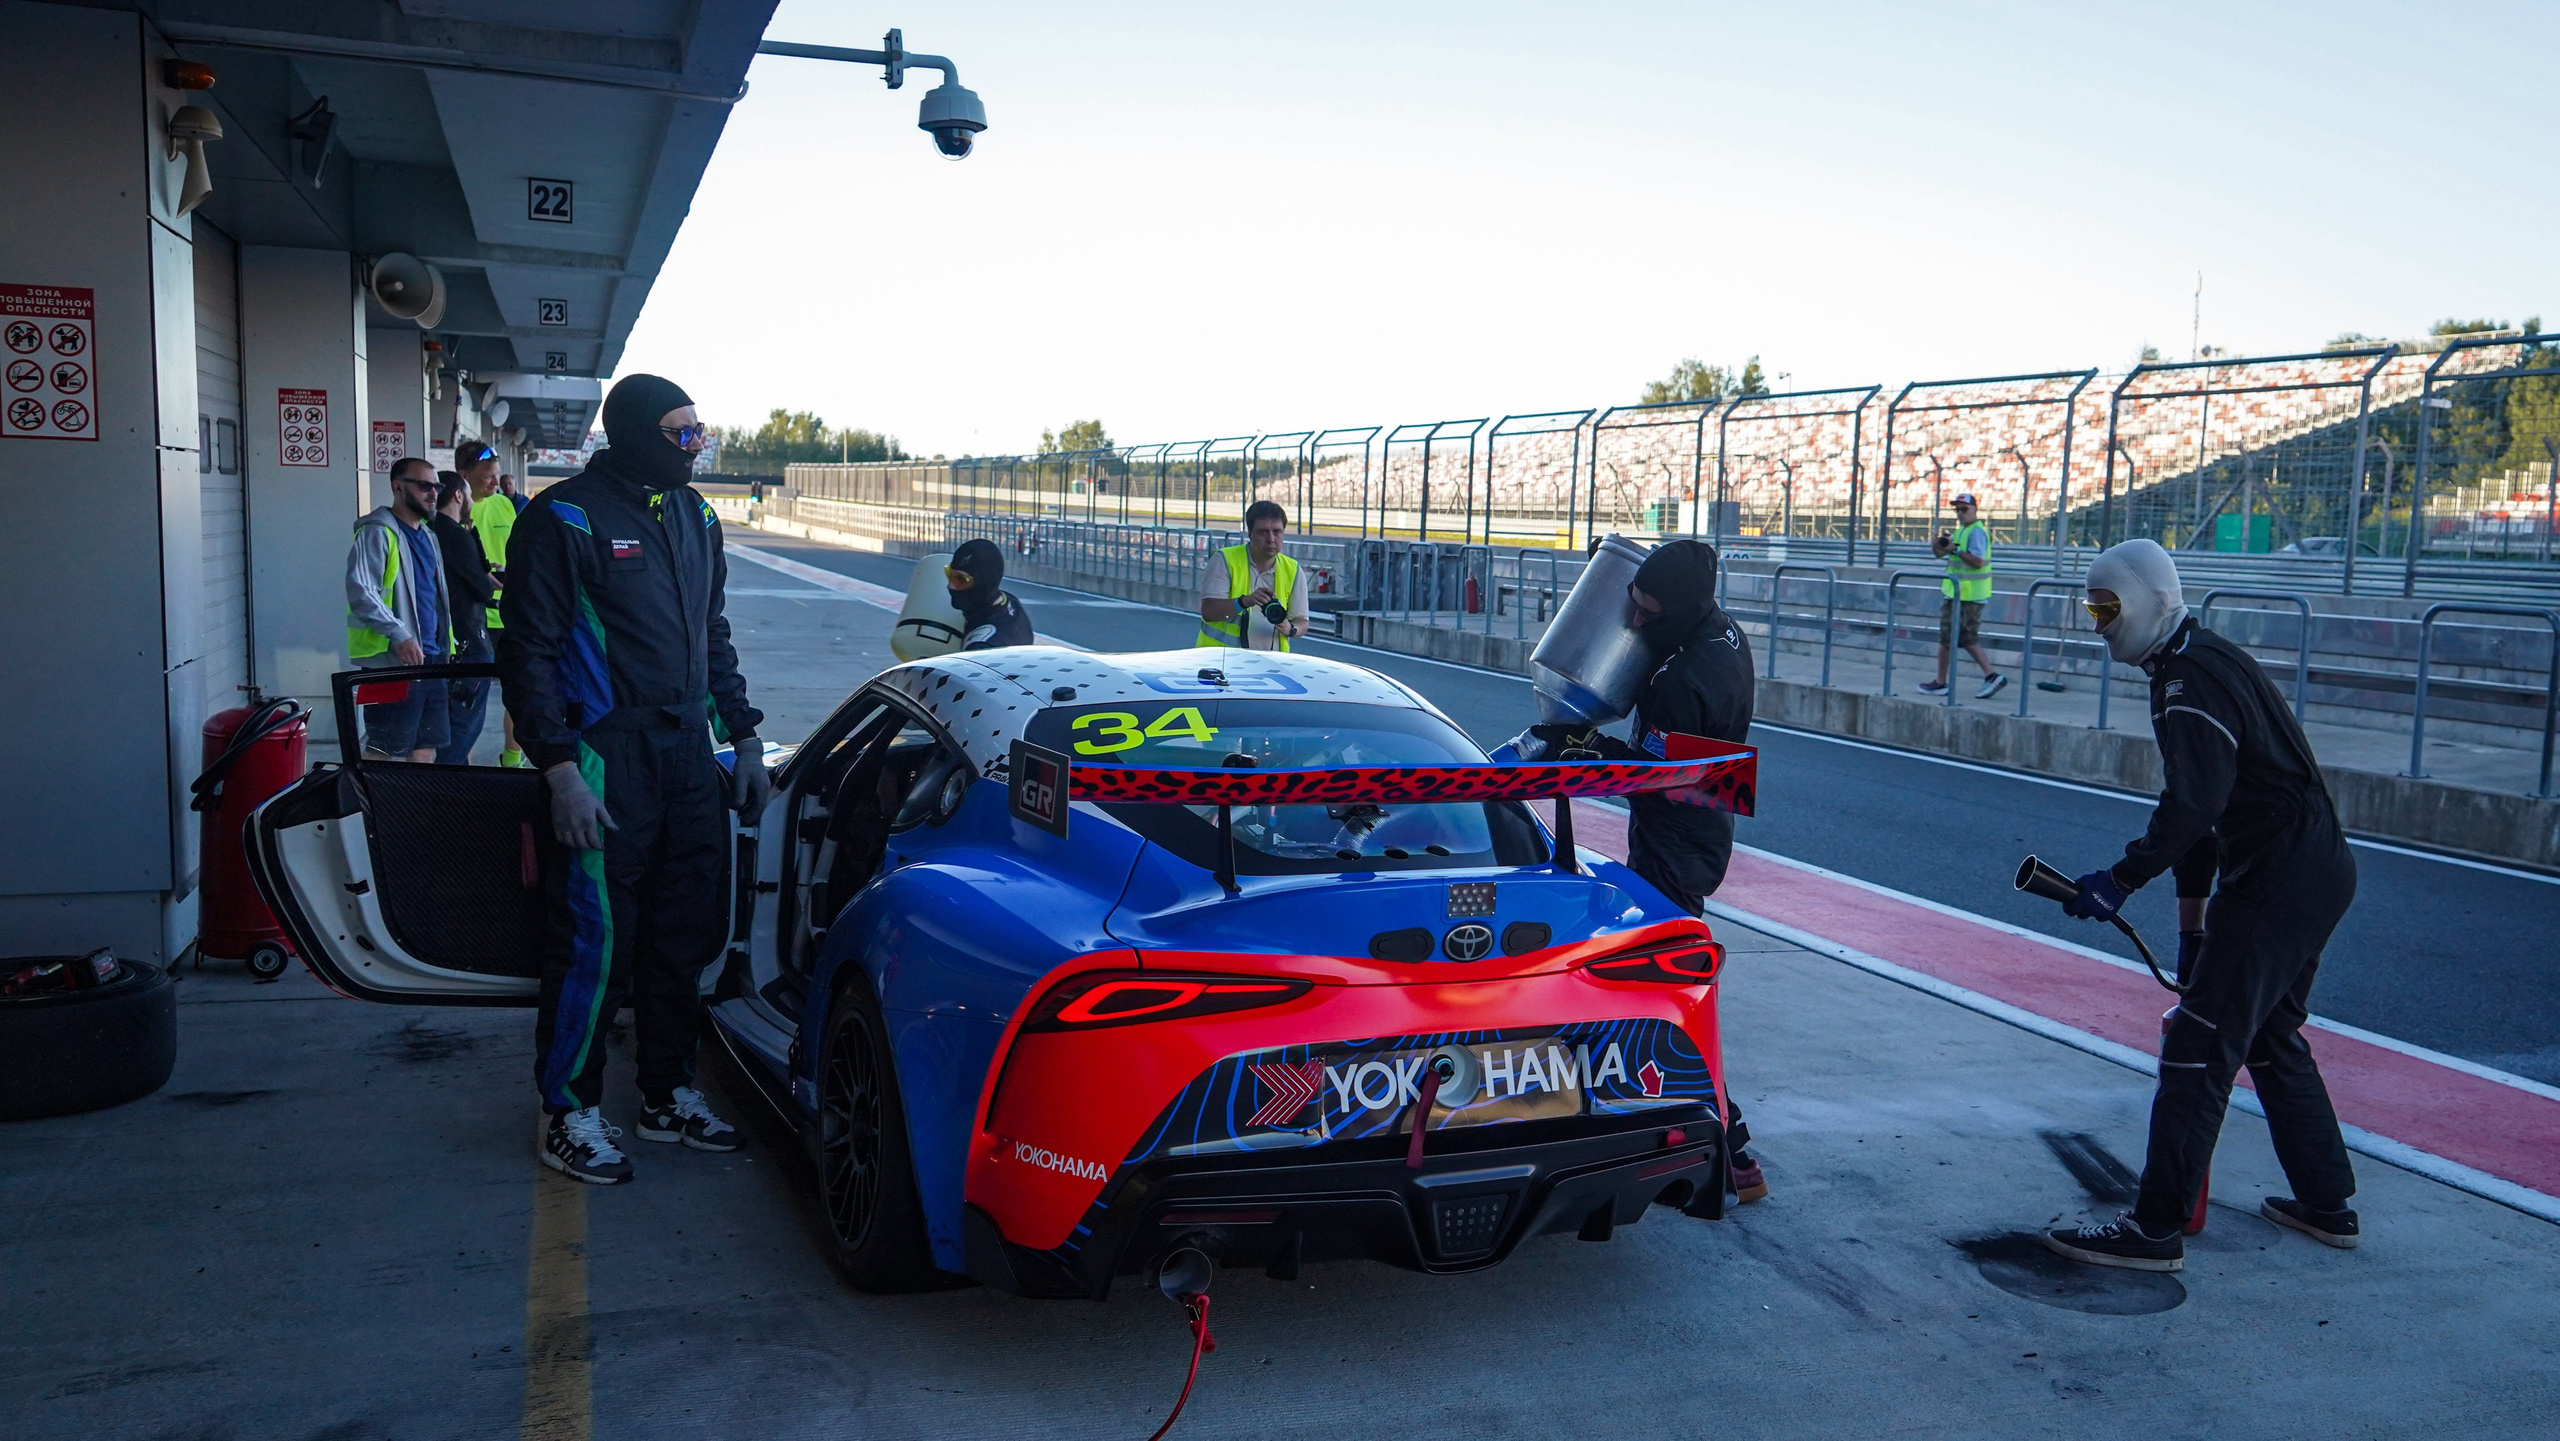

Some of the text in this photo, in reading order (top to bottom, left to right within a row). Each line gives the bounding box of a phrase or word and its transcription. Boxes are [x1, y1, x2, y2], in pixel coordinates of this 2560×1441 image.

[533, 185, 569, 217] 22
[27, 288, 61, 297] ЗОНА
[6, 304, 86, 316] ОПАСНОСТИ
[542, 303, 565, 322] 23
[548, 355, 565, 369] 24
[1071, 707, 1219, 756] 34
[990, 772, 1010, 784] PRAV
[1022, 779, 1053, 815] GR
[1325, 1042, 1629, 1113] YOKHAMA
[1015, 1141, 1108, 1183] YOKOHAMA
